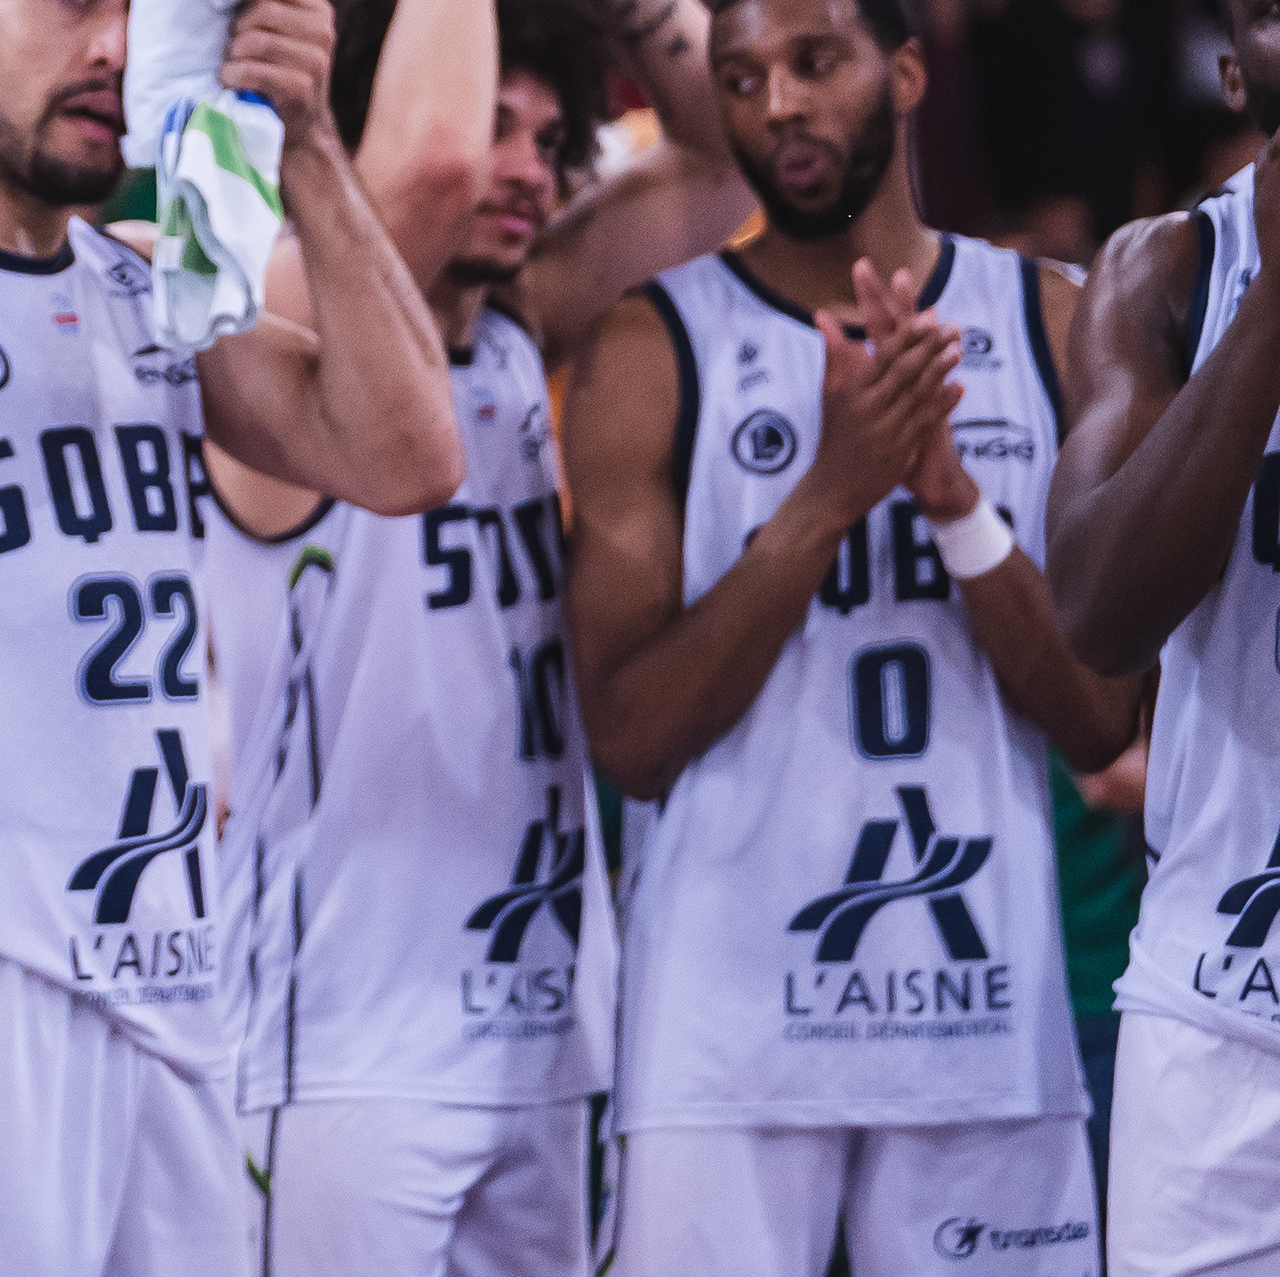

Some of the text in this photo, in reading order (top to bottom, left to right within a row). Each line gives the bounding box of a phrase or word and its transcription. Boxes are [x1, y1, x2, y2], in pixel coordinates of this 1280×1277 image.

[72, 574, 200, 708] 22
[851, 642, 932, 760] 0
[785, 965, 1013, 1016] L'AISNE
